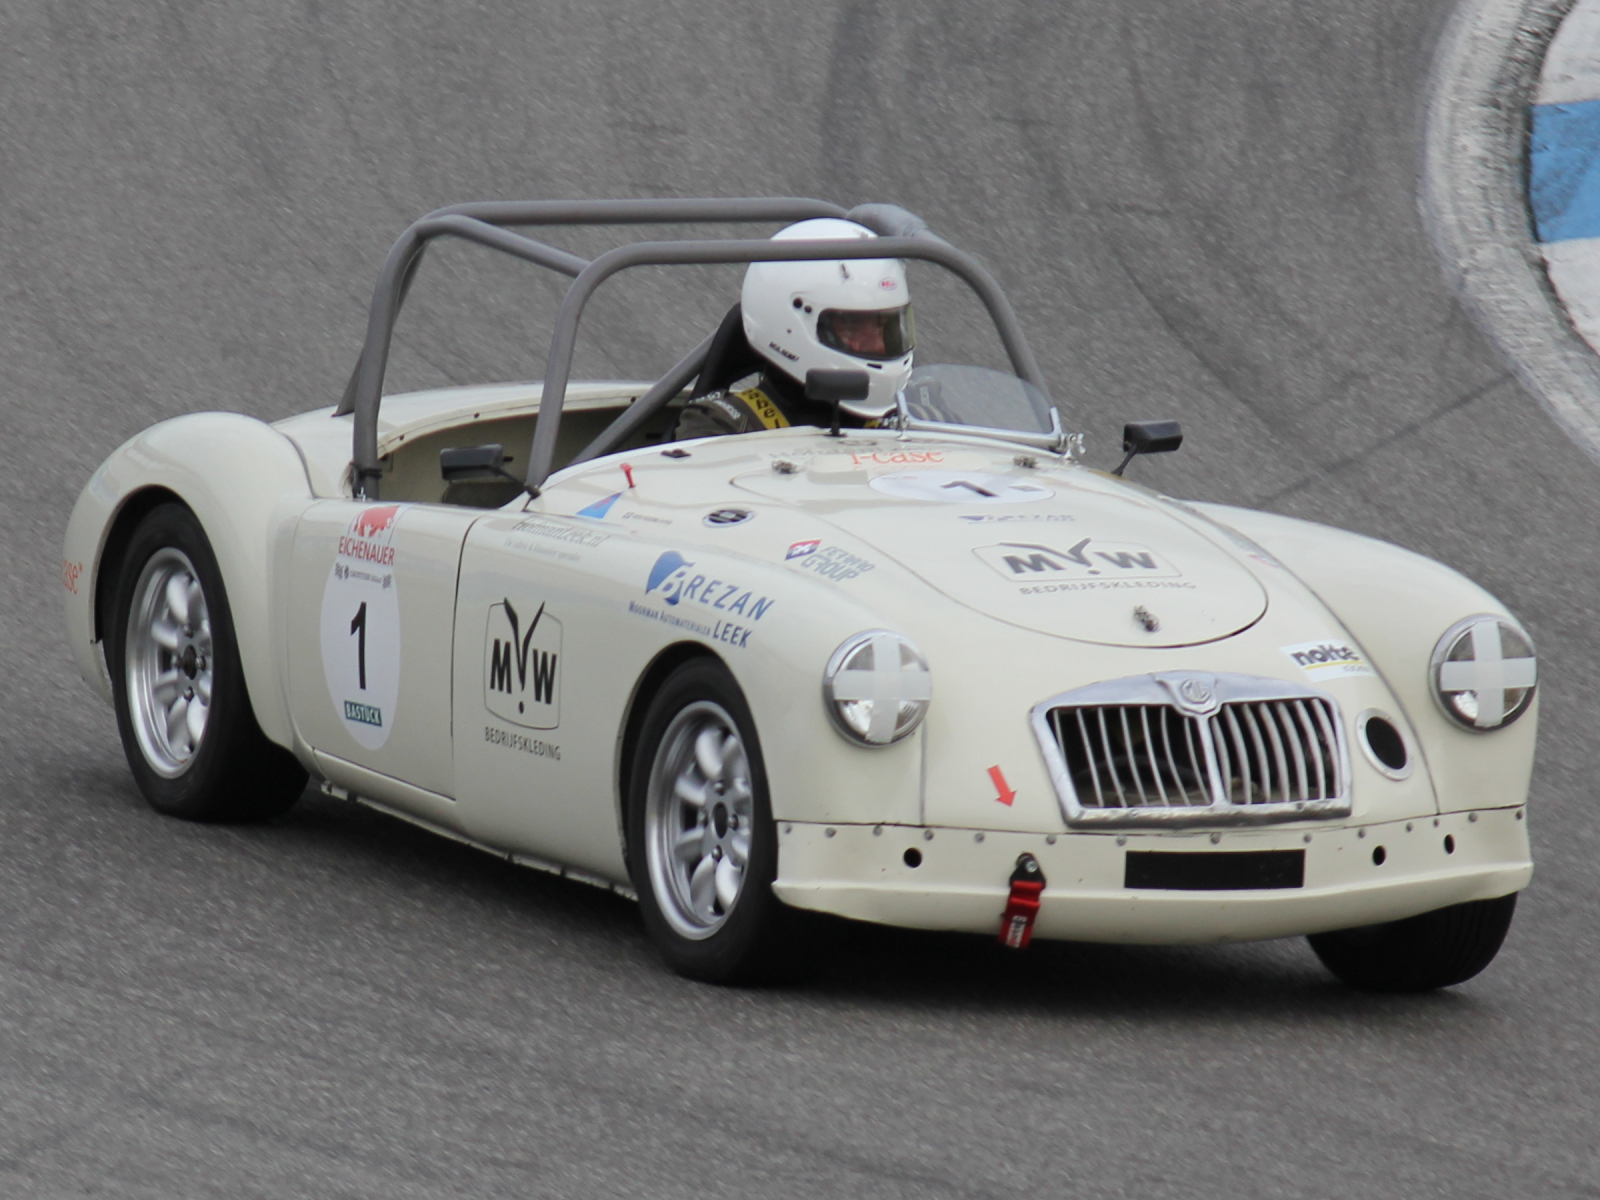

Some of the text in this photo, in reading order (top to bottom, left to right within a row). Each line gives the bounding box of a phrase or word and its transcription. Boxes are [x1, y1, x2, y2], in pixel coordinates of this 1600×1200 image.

[338, 536, 394, 566] EICHENAUER
[1018, 580, 1198, 596] BEDRIJFSKLEDING
[349, 601, 367, 691] 1
[712, 619, 754, 649] LEEK
[345, 701, 381, 725] BASTUCK
[483, 725, 562, 761] BEDRIJFSKLEDING
